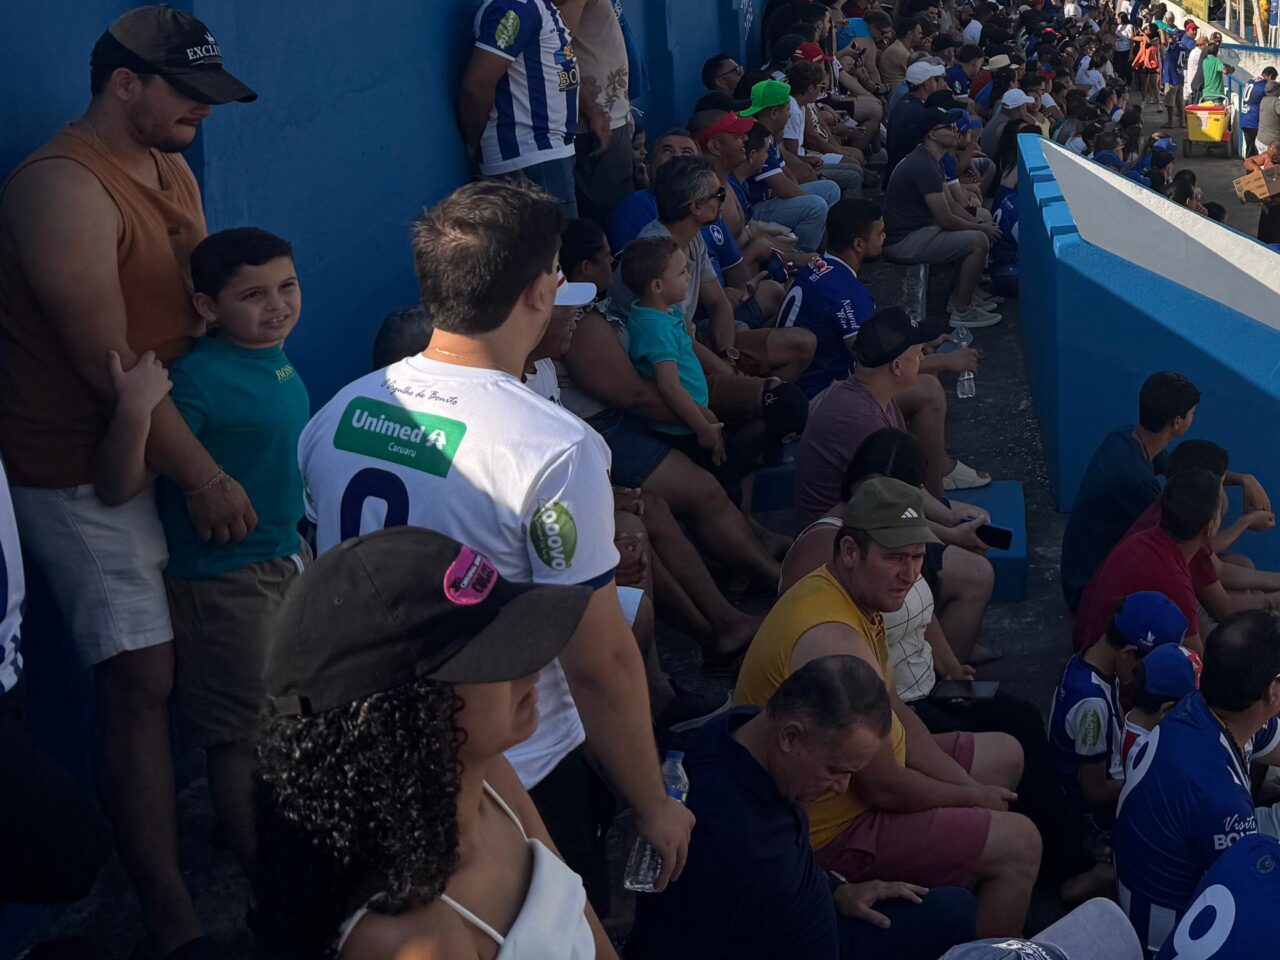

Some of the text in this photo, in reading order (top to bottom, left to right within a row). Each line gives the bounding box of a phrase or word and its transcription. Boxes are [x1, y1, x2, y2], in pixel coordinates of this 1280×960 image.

[840, 299, 861, 330] Natural
[351, 409, 426, 443] Unimed
[387, 442, 417, 457] Caruaru
